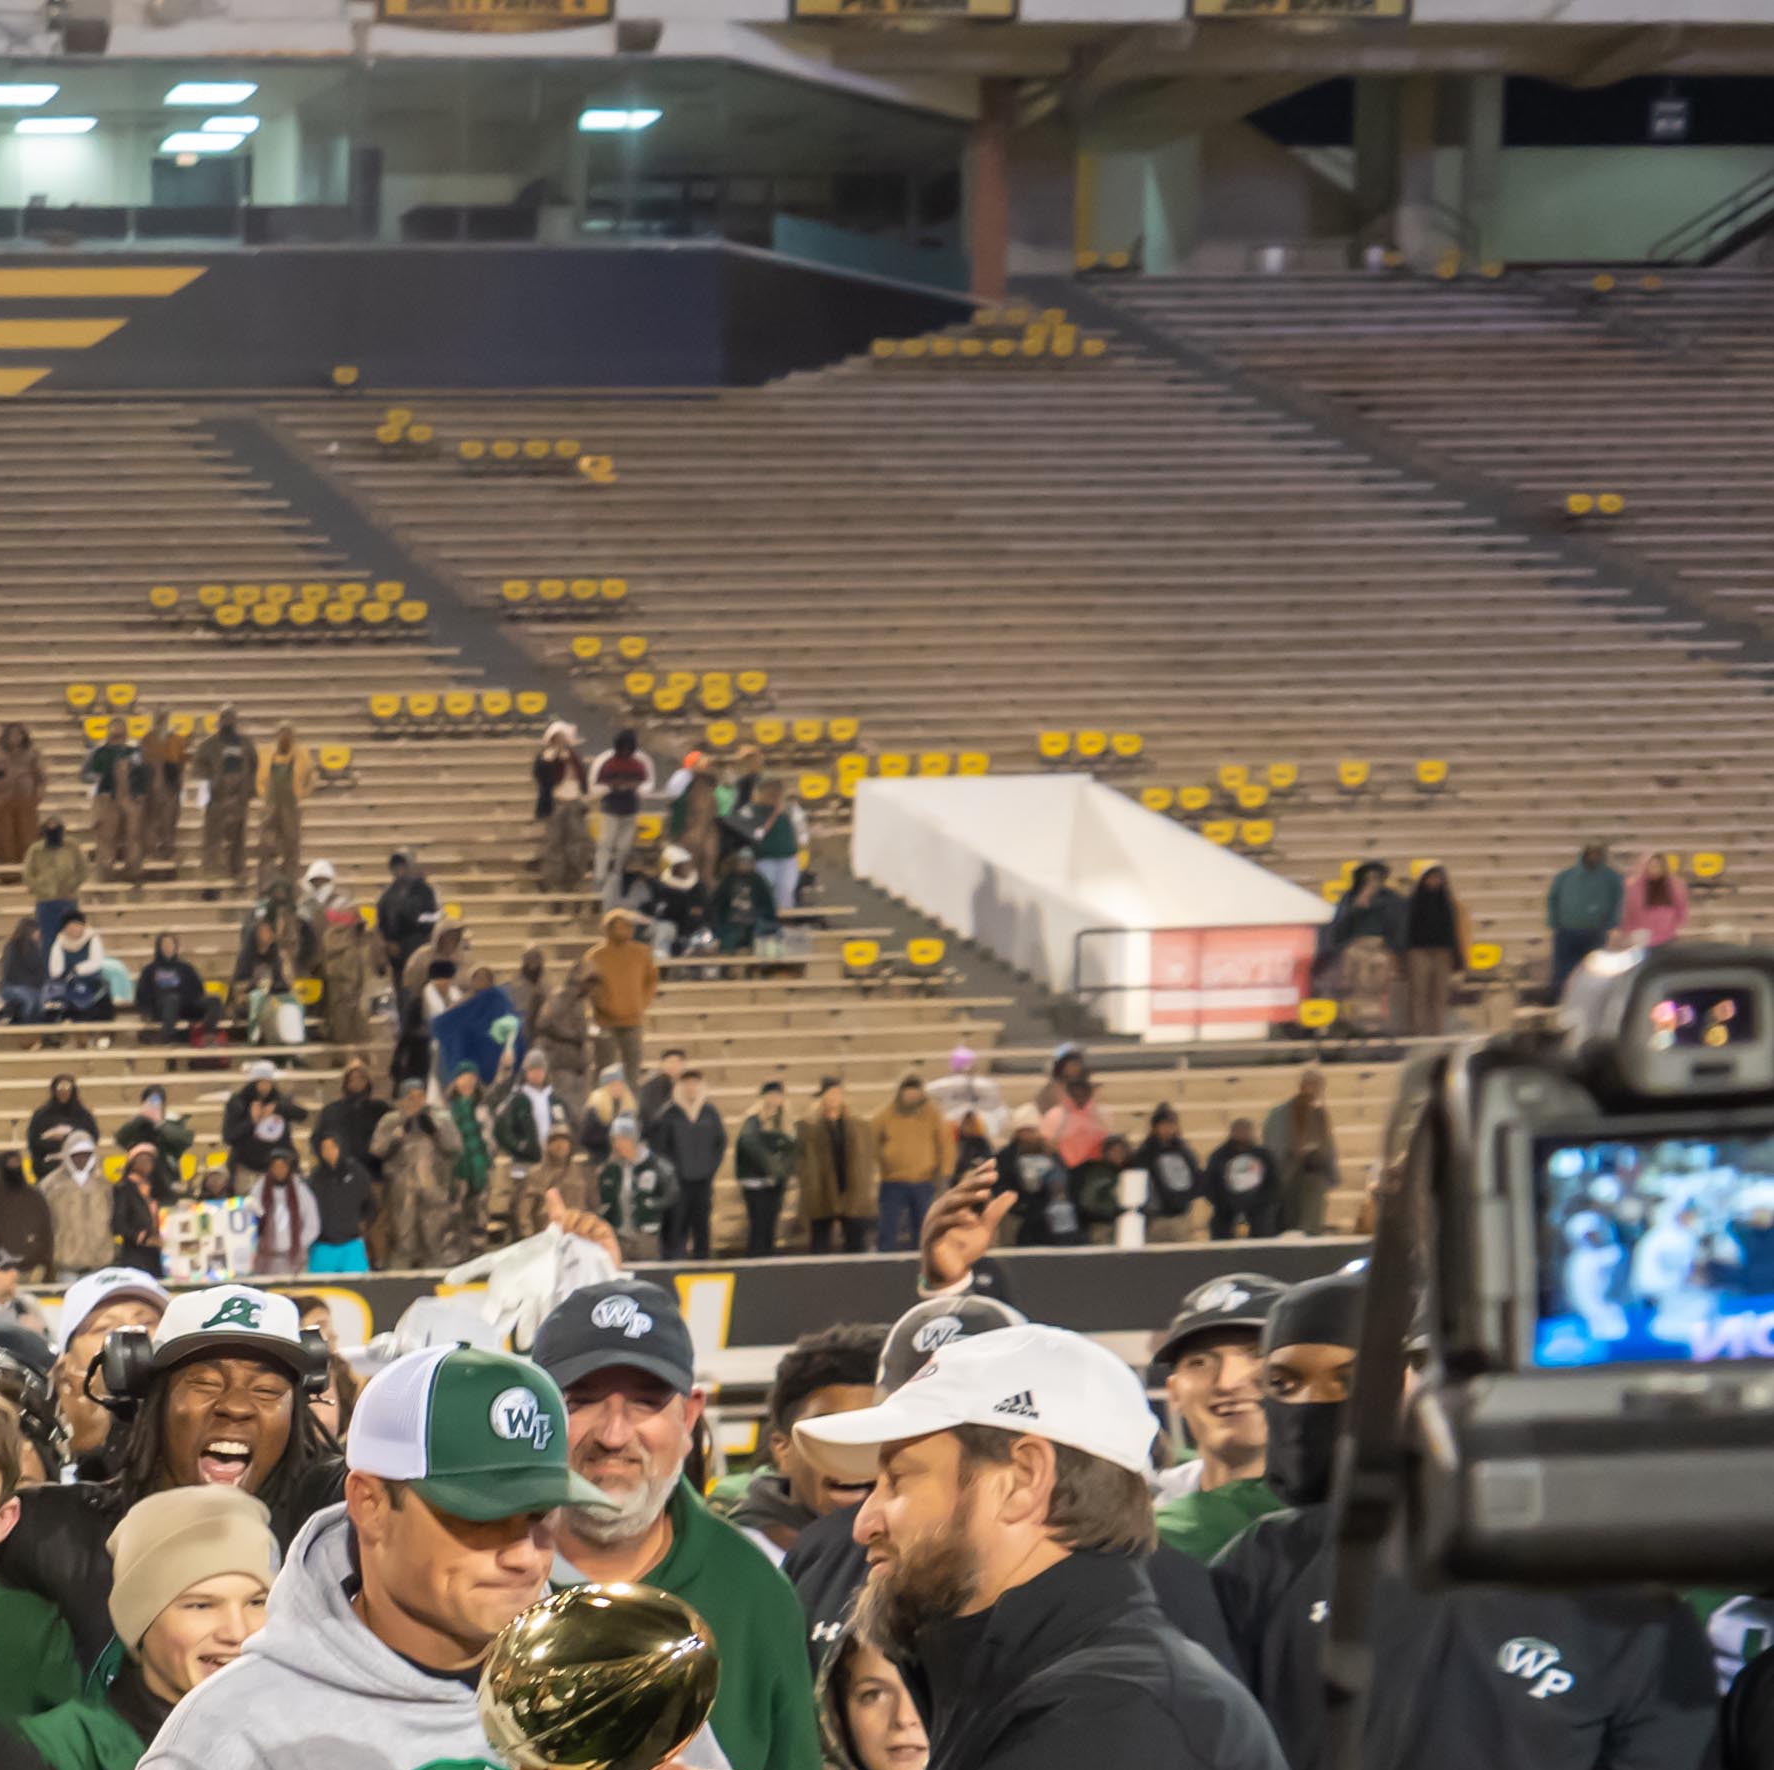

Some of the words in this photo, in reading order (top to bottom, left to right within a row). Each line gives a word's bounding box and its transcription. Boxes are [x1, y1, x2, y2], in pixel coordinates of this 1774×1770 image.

[591, 1294, 652, 1339] WP
[490, 1387, 553, 1450] WP
[1498, 1637, 1576, 1698] WP
